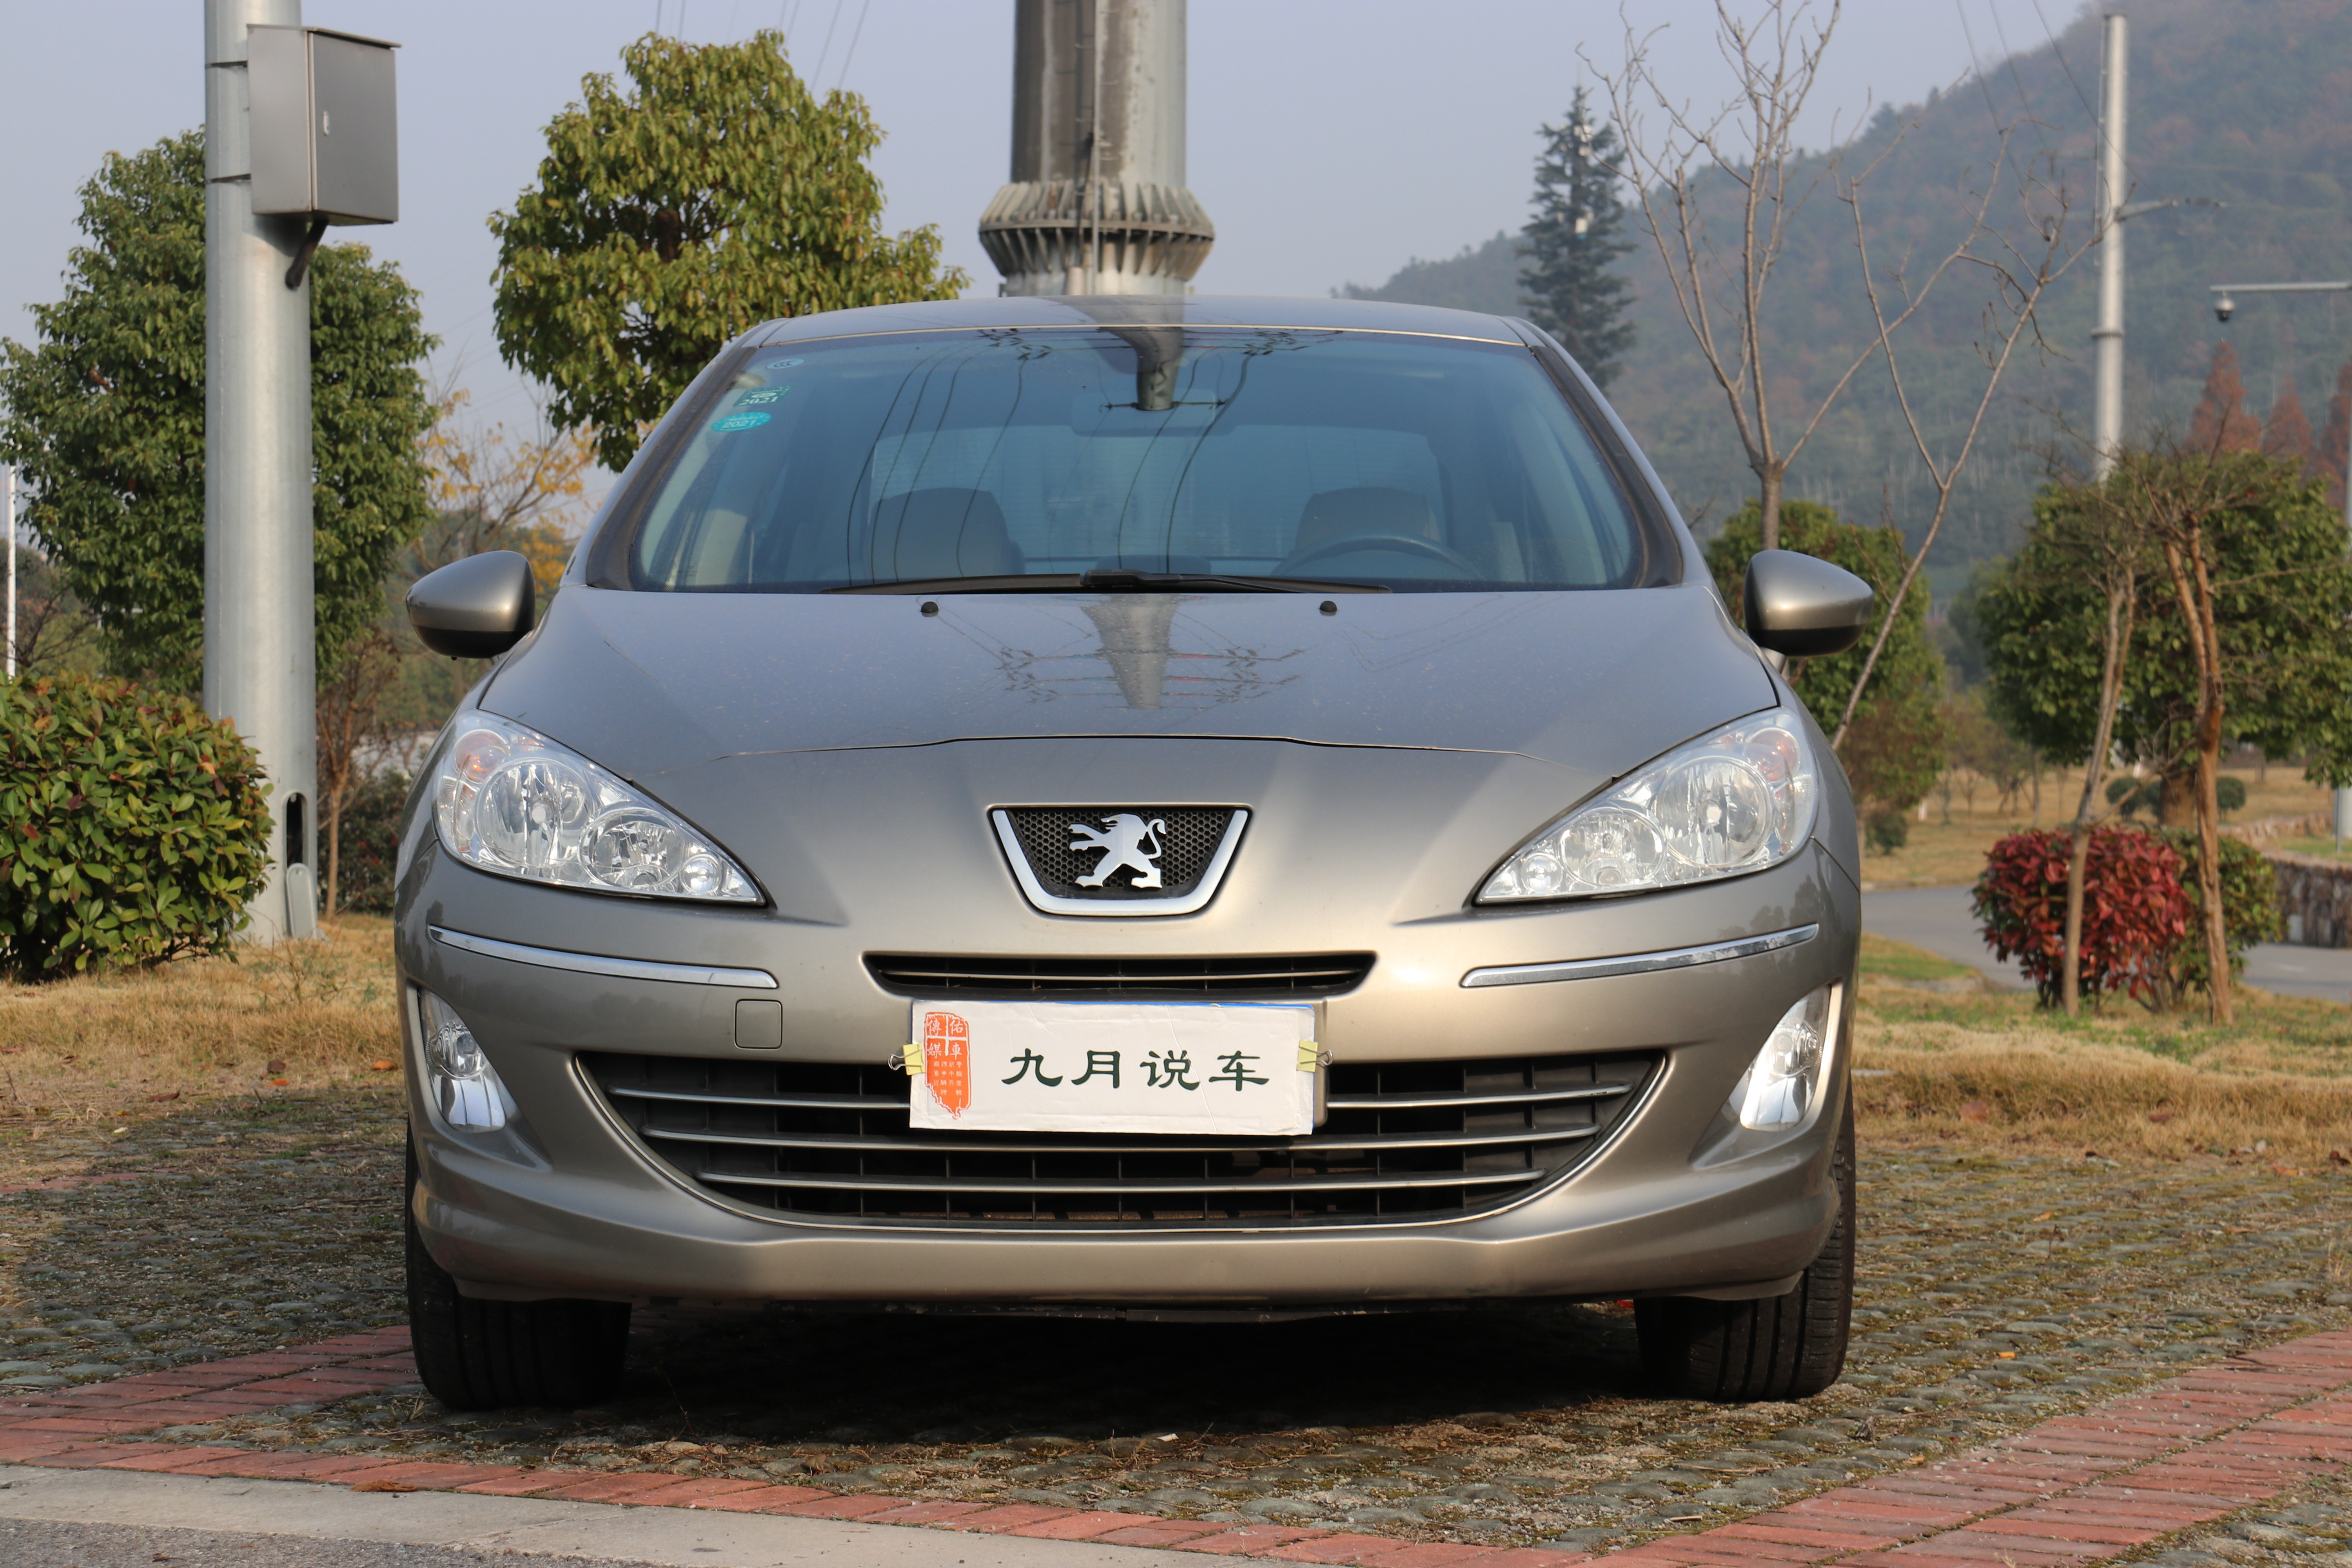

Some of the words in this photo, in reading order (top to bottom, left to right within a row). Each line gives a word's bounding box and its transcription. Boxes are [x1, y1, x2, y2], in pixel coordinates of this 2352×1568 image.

[739, 396, 778, 406] 2021
[720, 419, 757, 428] 2021
[1001, 1048, 1270, 1091] 九月说车
